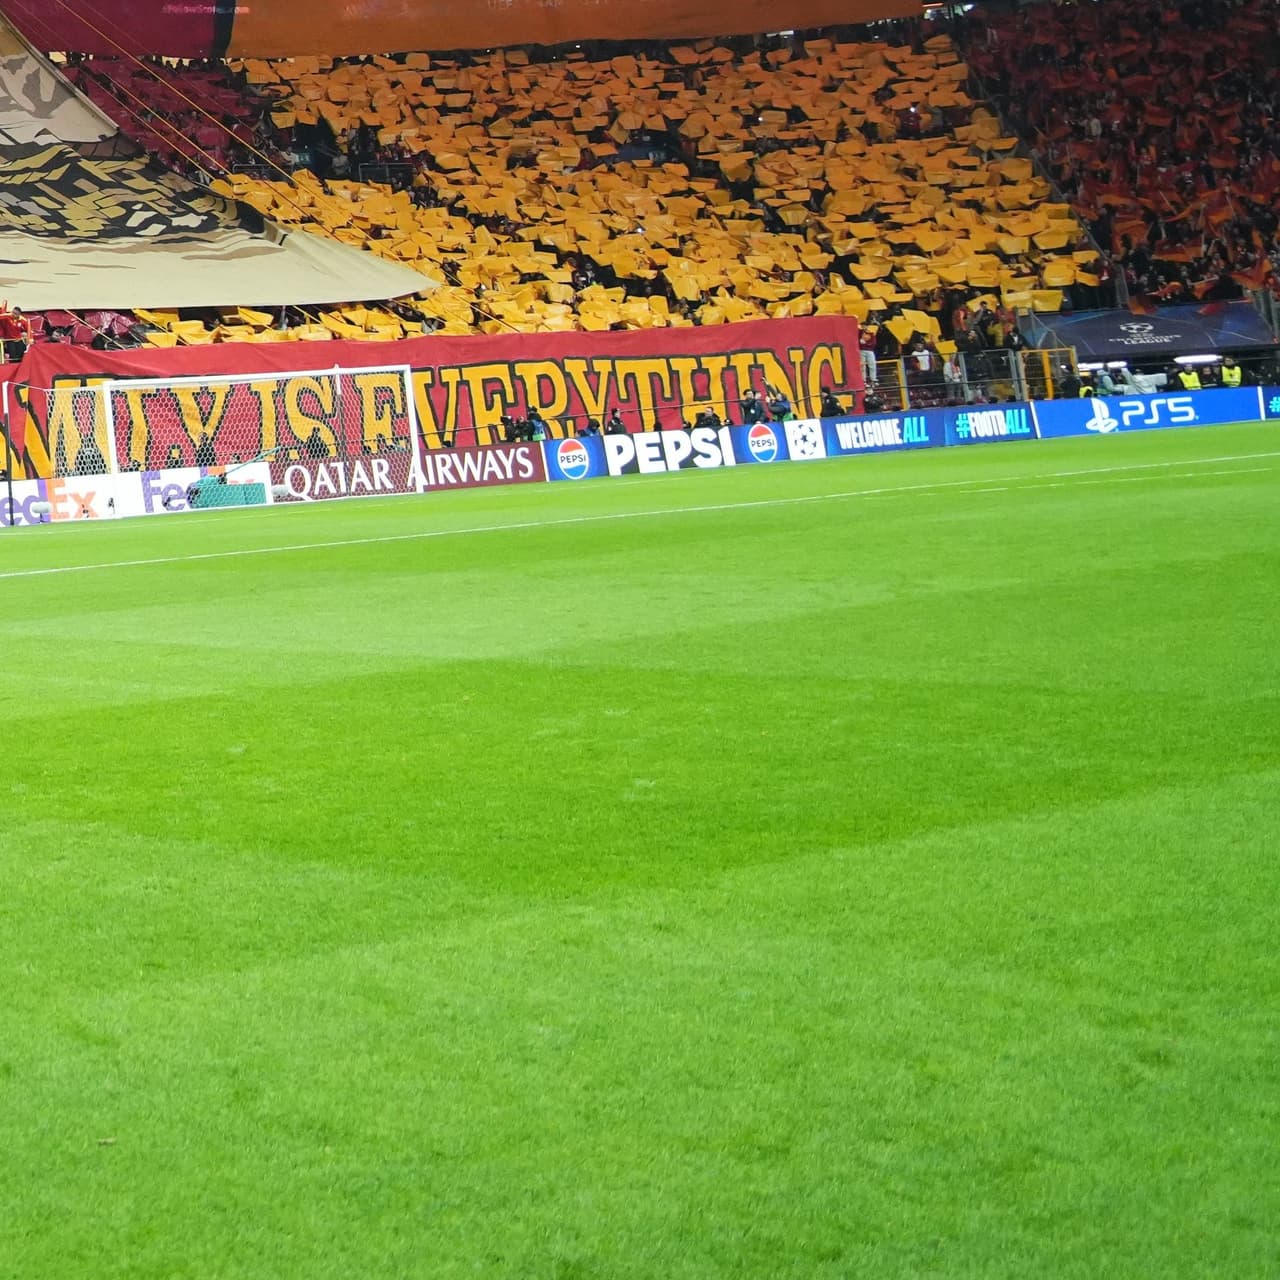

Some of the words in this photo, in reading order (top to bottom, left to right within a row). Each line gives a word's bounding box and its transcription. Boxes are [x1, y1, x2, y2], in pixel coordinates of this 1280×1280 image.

[247, 374, 339, 463] IS
[354, 342, 856, 455] EVERYTHING
[1119, 397, 1196, 426] PS5
[836, 418, 903, 449] WELCOME
[903, 416, 929, 443] ALL
[956, 409, 1030, 438] #FOOTBALL
[560, 454, 587, 464] PEPSI
[604, 426, 736, 476] PEPSI
[751, 439, 776, 449] PEPSI
[284, 458, 394, 501] QATAR
[407, 446, 534, 487] AIRWAYS
